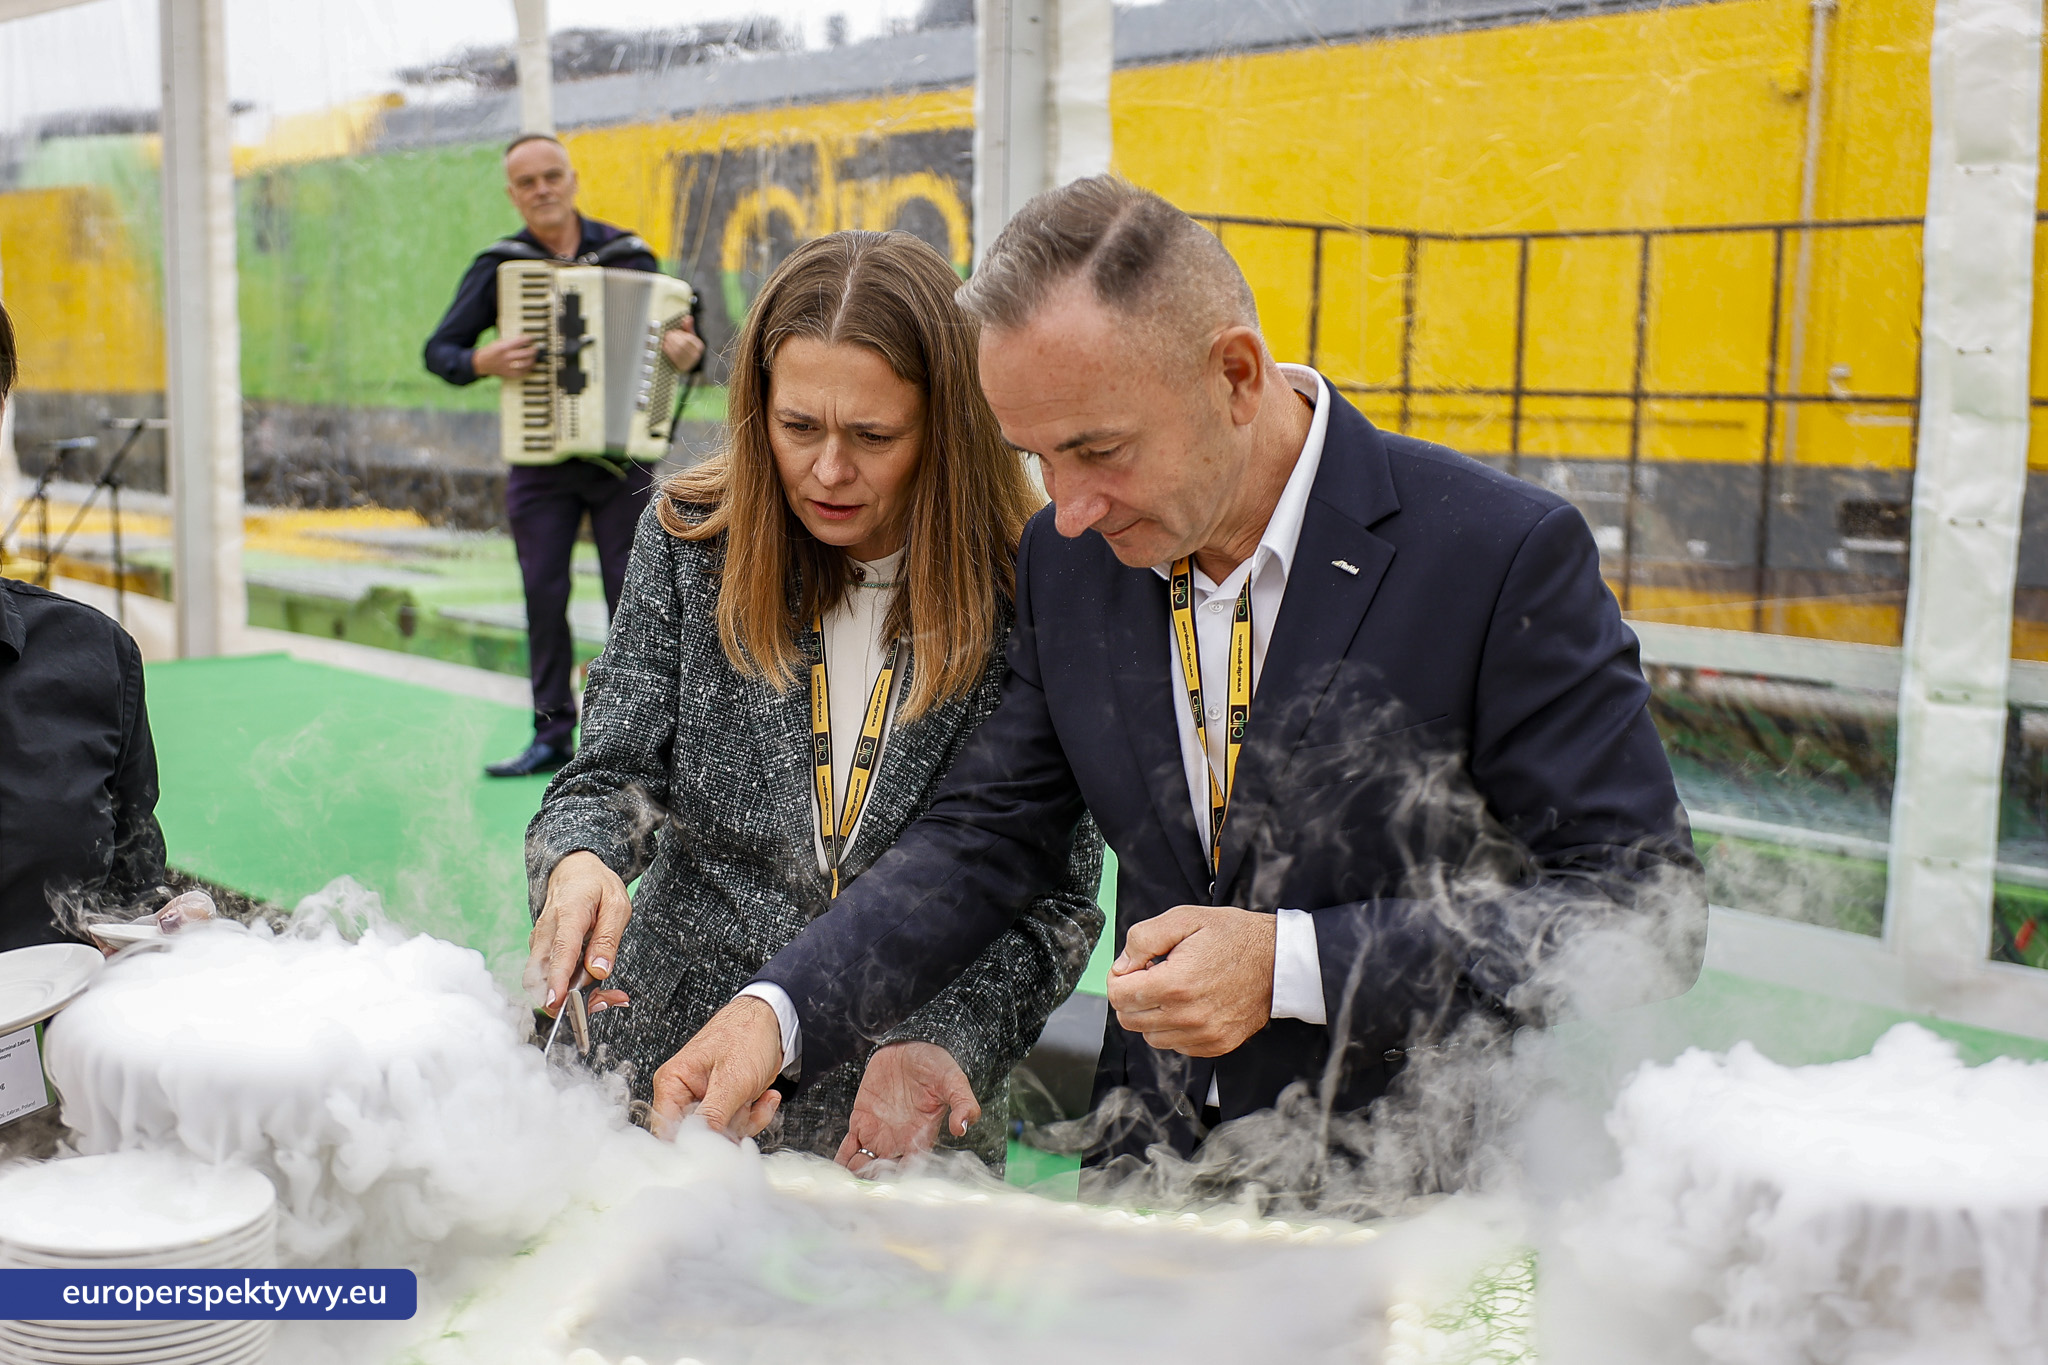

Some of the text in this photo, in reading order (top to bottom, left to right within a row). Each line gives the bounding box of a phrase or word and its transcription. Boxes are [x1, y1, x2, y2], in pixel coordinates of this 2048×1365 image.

[1172, 580, 1188, 604] clip
[1192, 696, 1202, 722] clip
[1231, 710, 1248, 738] clip
[816, 737, 829, 761] clip
[859, 741, 874, 764] clip
